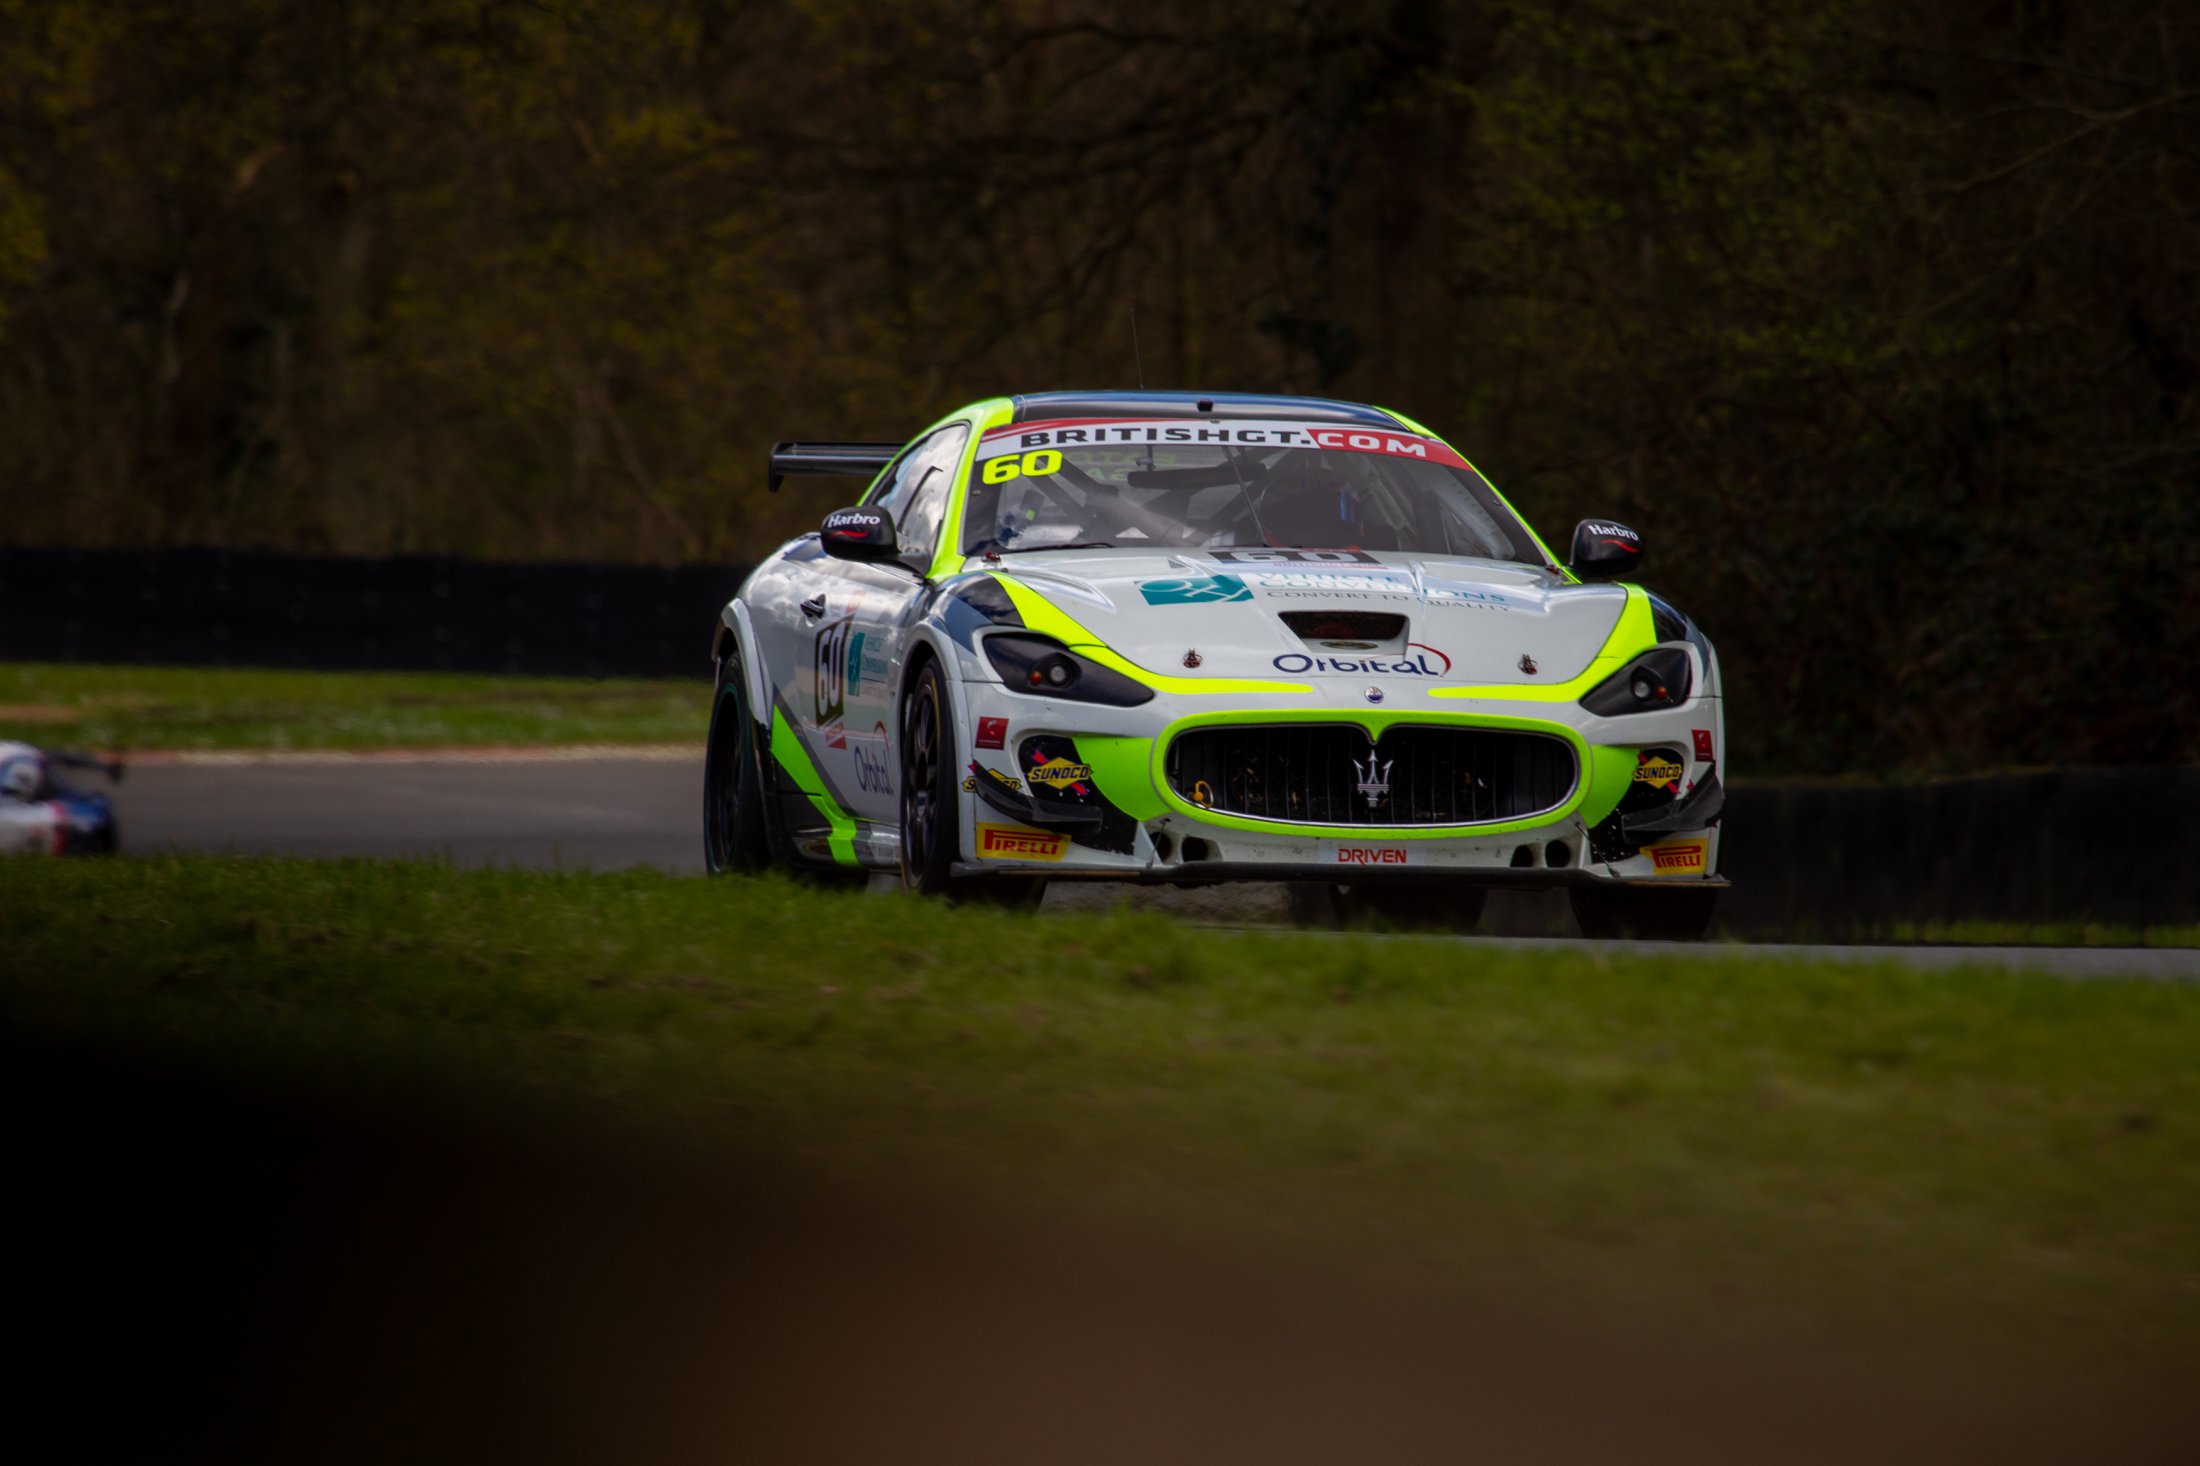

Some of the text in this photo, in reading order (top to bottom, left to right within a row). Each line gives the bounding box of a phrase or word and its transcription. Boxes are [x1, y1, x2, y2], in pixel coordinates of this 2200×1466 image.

[1020, 426, 1427, 458] BRITISHGT.COM
[982, 449, 1063, 486] 60
[827, 512, 881, 528] Harbro
[1586, 523, 1640, 542] Harbro
[1229, 550, 1359, 564] 60
[1266, 590, 1373, 600] CONVERT
[1381, 593, 1409, 601] TO
[1272, 653, 1439, 677] Orbital
[854, 745, 895, 796] Orbital
[1031, 766, 1090, 781] SUNOCO
[1635, 765, 1681, 781] SUNOCO
[984, 828, 1062, 856] PIRELLI
[1338, 848, 1407, 865] DRIVEN
[1650, 844, 1703, 868] PIRELLI
